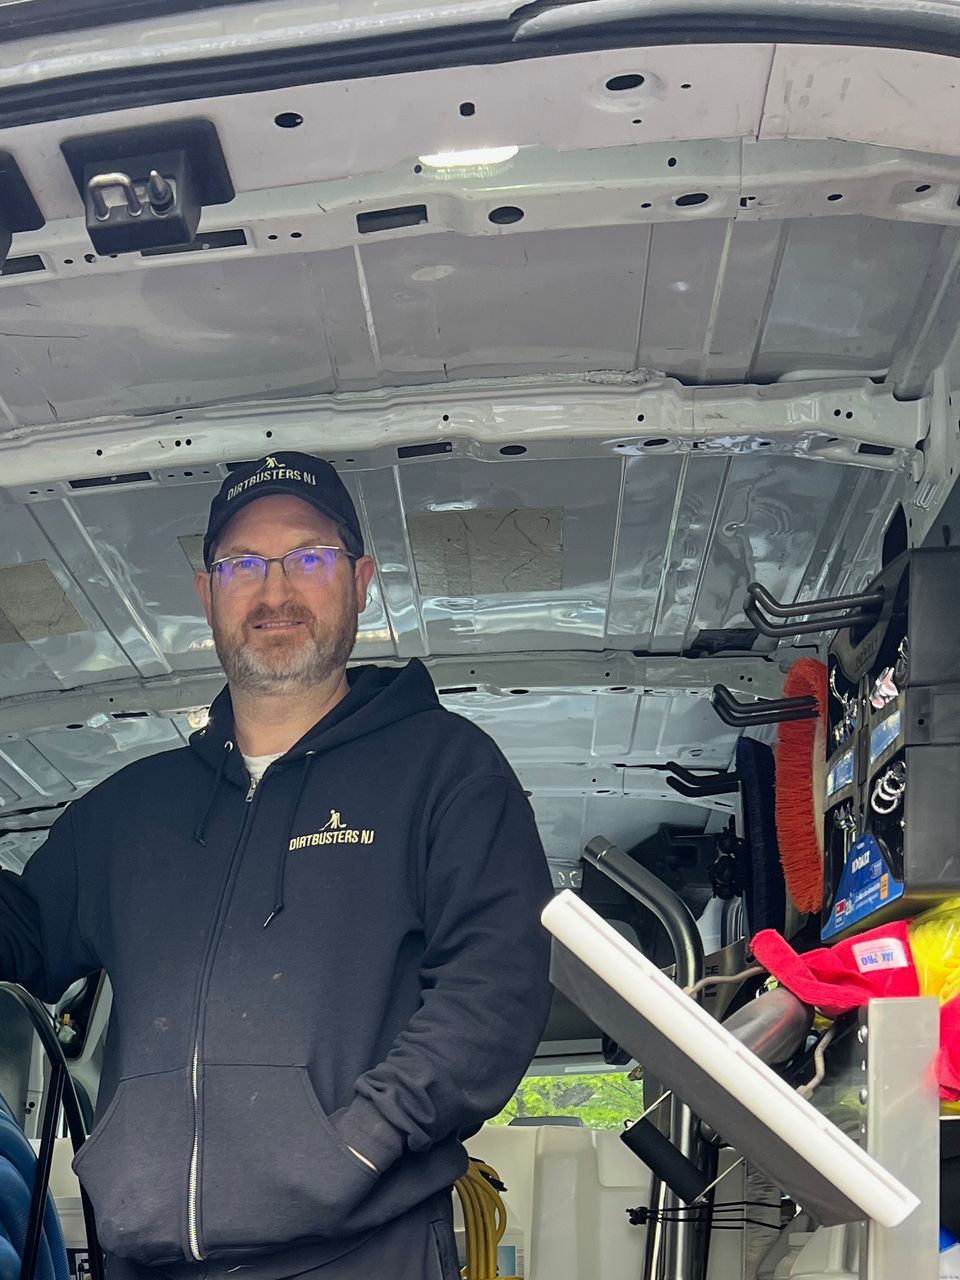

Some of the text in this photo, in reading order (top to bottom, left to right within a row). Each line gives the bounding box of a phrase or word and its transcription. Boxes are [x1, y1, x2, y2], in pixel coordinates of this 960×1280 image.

[227, 469, 316, 500] DIRTBUSTERS NJ
[288, 829, 375, 851] DIRTBUSTERS NJ
